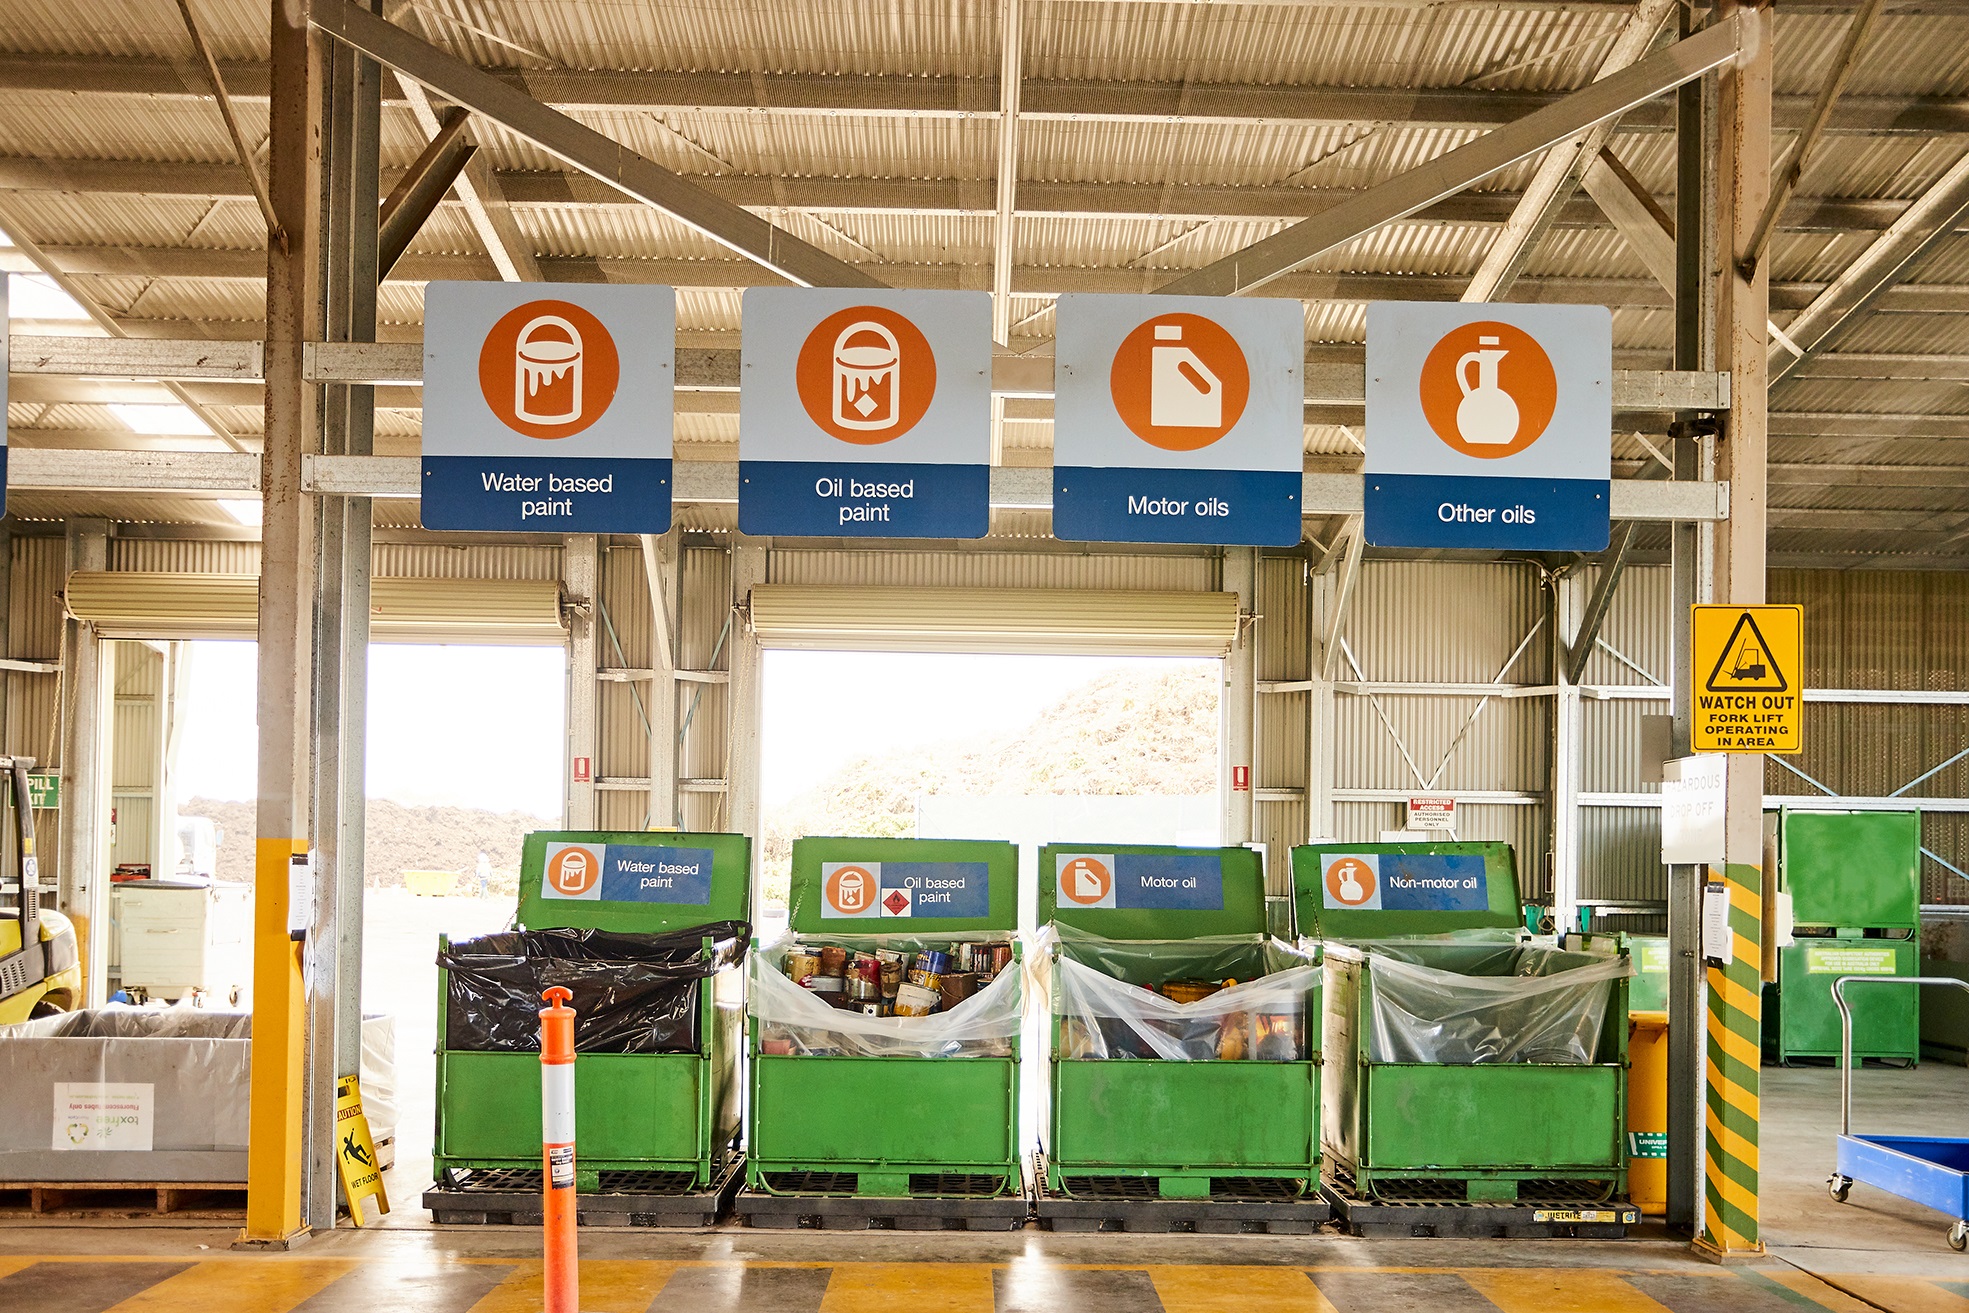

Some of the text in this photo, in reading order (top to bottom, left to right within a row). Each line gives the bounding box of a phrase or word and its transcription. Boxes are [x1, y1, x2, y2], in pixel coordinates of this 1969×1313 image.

[481, 472, 613, 493] Water based
[815, 477, 914, 498] Oil based
[521, 497, 573, 520] paint
[1128, 495, 1230, 517] Motor oils
[1437, 502, 1536, 524] Other oils
[839, 502, 890, 526] paint
[1699, 696, 1794, 709] WATCH OUT
[1709, 714, 1784, 723] FORK LIFT
[1705, 726, 1789, 735] OPERATING
[1717, 738, 1775, 746] IN AREA
[28, 778, 54, 790] PILL
[1666, 774, 1720, 792] HAZARDOUS
[1671, 801, 1714, 818] DROP OFF
[617, 859, 700, 875] Water based
[640, 875, 674, 890] paint
[903, 876, 966, 889] Oil based
[1140, 875, 1197, 888] Motor oil
[1389, 876, 1478, 889] Non-motor oil
[919, 891, 951, 905] paint
[69, 1103, 140, 1111] Fluorescen ubes only
[338, 1104, 362, 1120] AUTION
[95, 1115, 139, 1127] toxfree
[350, 1172, 379, 1189] WET FLOOR
